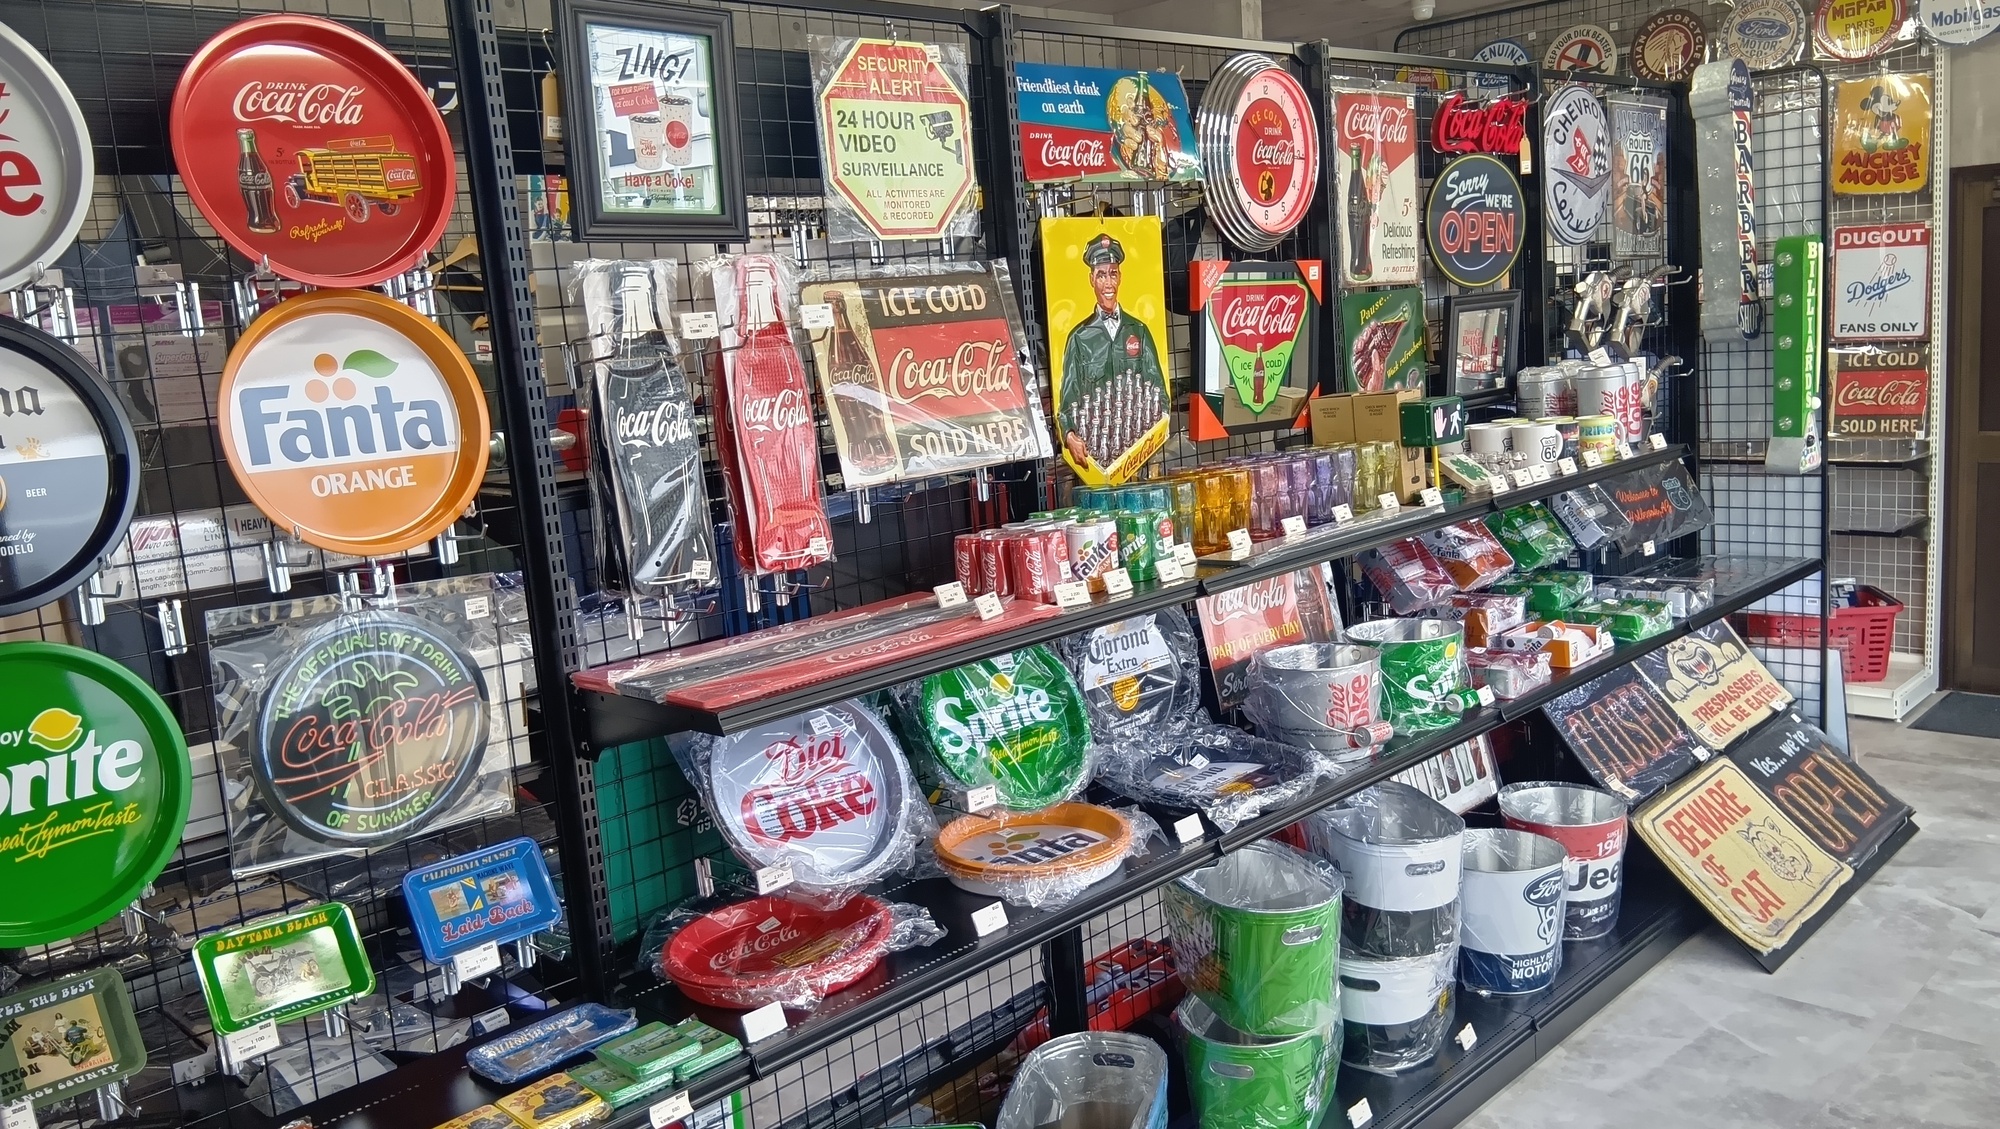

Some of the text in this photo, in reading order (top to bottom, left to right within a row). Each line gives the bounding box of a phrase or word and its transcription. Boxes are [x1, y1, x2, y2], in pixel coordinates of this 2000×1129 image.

[1738, 1, 1796, 25] AMERICAN TRADITION
[1932, 6, 2000, 28] Mobilgas
[1745, 20, 1782, 37] Ford
[1845, 18, 1875, 33] PARTS
[1548, 28, 1614, 70] KEEP YOUR DICK BEATERS
[1635, 14, 1701, 80] INDIAN MOTORCYCLE
[1740, 40, 1778, 51] MOTOR
[1750, 51, 1763, 59] CO
[615, 44, 695, 85] ZING!
[858, 56, 929, 75] SECURITY
[266, 82, 309, 91] DRINK
[611, 86, 633, 96] FOR YOUR
[869, 79, 923, 97] ALERT
[1016, 77, 1101, 97] Friendliest drink
[1263, 86, 1269, 95] 12
[233, 81, 366, 125] Coca-Cola
[635, 96, 656, 106] Coke
[1042, 100, 1085, 115] on earth
[1360, 104, 1382, 113] DRINK
[837, 110, 915, 131] 24 HOUR
[1250, 108, 1283, 130] ICE COLD
[1292, 119, 1297, 129] 2
[1344, 102, 1409, 144] Coca-Cola
[1434, 93, 1528, 155] Coca-Cola
[838, 134, 897, 153] VIDEO
[1264, 127, 1283, 136] DRINK
[1041, 140, 1107, 168] Coca-Cola
[1252, 138, 1295, 167] Coca-Cola
[1629, 138, 1651, 151] ROUTE
[1841, 142, 1922, 169] MICKEY
[386, 168, 416, 182] Coca-Cola
[625, 172, 695, 188] Have a Coke!
[843, 162, 944, 177] SURVEILLANCE
[1630, 154, 1650, 185] 66
[1839, 163, 1920, 186] MOUSE
[867, 189, 945, 198] ALL ACTIVITIES ARE
[1292, 180, 1296, 190] 4
[1446, 170, 1489, 201] Sorry
[884, 200, 931, 209] MONITORED
[1247, 202, 1252, 211] 7
[1281, 202, 1286, 212] 5
[1485, 193, 1513, 209] WE'RE
[1735, 120, 1756, 295] BARBER
[883, 212, 934, 221] & RECORDED
[1264, 211, 1269, 220] 6
[290, 218, 328, 240] Refresh
[312, 217, 346, 242] yourself!
[1383, 222, 1413, 239] Delicious
[1440, 211, 1514, 253] OPEN
[1839, 229, 1926, 246] DUGOUT
[1381, 243, 1416, 262] Refreshing
[1392, 265, 1415, 274] BOTTLES
[1246, 294, 1265, 302] DRINK
[1847, 269, 1911, 303] Dodgers
[878, 284, 987, 317] ICE COLD
[1359, 294, 1392, 326] Pause...
[1222, 295, 1301, 338] Coca-Cola
[1740, 302, 1760, 333] SHOP
[1806, 241, 1818, 409] BILLIARDS
[1840, 322, 1919, 333] FANS ONLY
[1241, 359, 1282, 371] ICE COLD
[1387, 336, 1423, 379] Work refreshed
[1462, 357, 1488, 375] Coke
[1847, 352, 1919, 367] ICE COLD
[830, 364, 876, 386] Coca-Cola
[889, 339, 1012, 405] Coca-Cola
[1838, 380, 1923, 407] Coca-Cola
[743, 388, 809, 433] Coca-Cola
[1628, 382, 1641, 435] Coke
[239, 385, 448, 466] Fanta
[616, 400, 693, 449] Coca-Cola
[1841, 419, 1919, 433] SOLD HERE
[909, 417, 1025, 462] SOLD HERE
[1123, 434, 1155, 478] Coca-Cola
[1544, 446, 1557, 459] 66
[26, 488, 47, 498] BEER
[311, 465, 417, 497] ORANGE
[1670, 490, 1689, 506] 66
[241, 518, 267, 531] HEAVY
[1562, 504, 1587, 532] Corona
[22, 529, 36, 543] by
[1499, 527, 1523, 542] Sprite
[1437, 545, 1461, 560] Fanta
[1026, 549, 1042, 595] Coca-Cola
[1088, 629, 1150, 666] Corona
[1212, 620, 1300, 661] PART OF EVERY DAY
[274, 630, 463, 722] THE OFFICIAL SOFT DRINK
[1107, 657, 1139, 674] Extra
[964, 686, 989, 701] Enjoy
[1326, 682, 1348, 728] Diet
[1692, 669, 1764, 723] TRESPASSERS
[1729, 682, 1782, 722] BE EATEN
[281, 690, 455, 769] Coca-Cola
[936, 686, 1052, 757] Sprite
[1565, 680, 1685, 781] CLOSED
[765, 730, 847, 786] Diet
[1750, 728, 1811, 779] Yes... we're
[364, 761, 457, 801] CLASSIC
[326, 791, 436, 832] OF SUMMER
[741, 774, 877, 844] Coke
[1773, 746, 1889, 853] OPEN
[1662, 779, 1752, 859] BEWARE
[422, 847, 517, 882] CALIFORNIA SUNSET
[1701, 854, 1734, 888] OF
[1730, 869, 1787, 924] CAT
[216, 912, 328, 952] DAYTONA BEACH
[441, 899, 535, 943] Laid-Back
[1512, 955, 1545, 968] HIGHLY
[29, 979, 95, 1008] THE BEST
[58, 1064, 120, 1090] COUNTY
